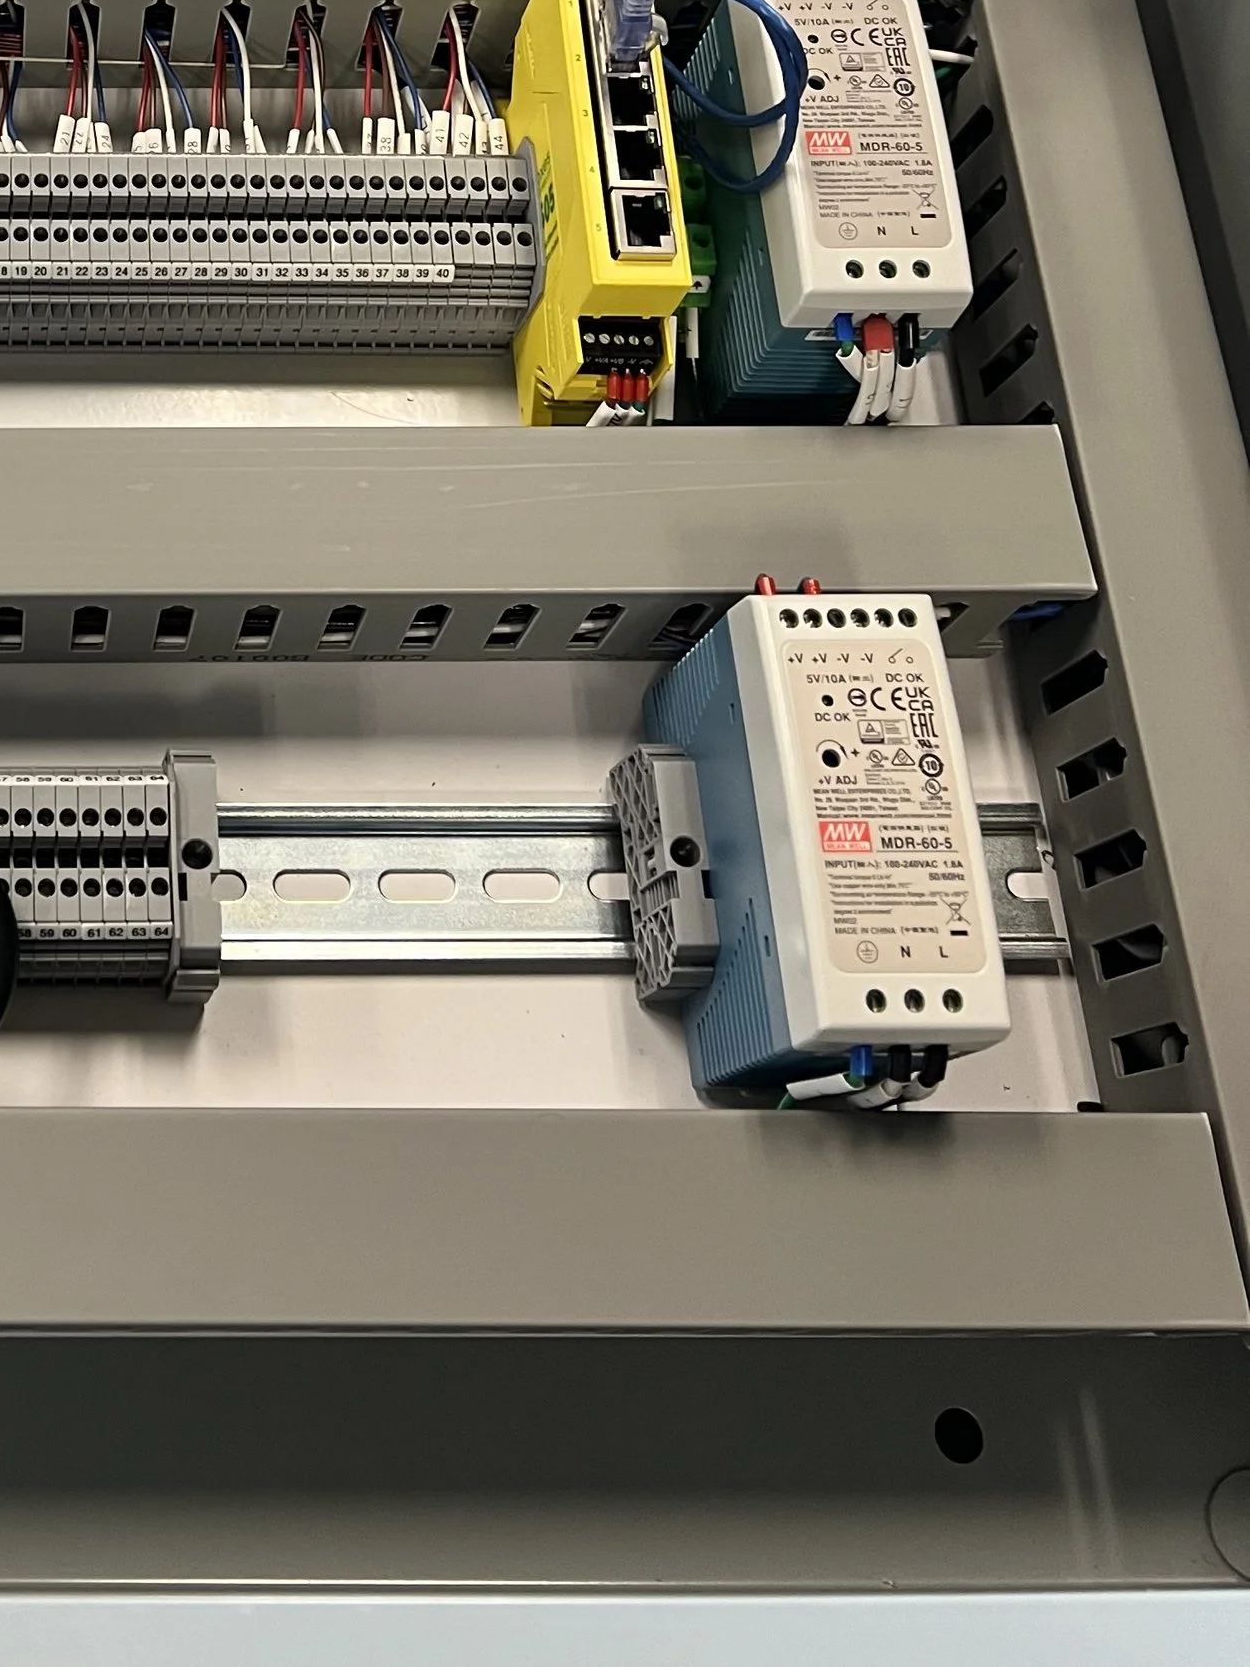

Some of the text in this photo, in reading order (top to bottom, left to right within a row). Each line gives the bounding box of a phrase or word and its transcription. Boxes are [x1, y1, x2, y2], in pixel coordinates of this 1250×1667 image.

[778, 3, 792, 11] +V
[799, 3, 813, 11] +V
[842, 3, 853, 11] -V
[794, 18, 829, 26] 5V/10A
[864, 17, 898, 25] DC OK
[881, 27, 903, 37] UK
[851, 28, 883, 47] CE
[883, 37, 907, 47] CA
[819, 47, 833, 55] OK
[575, 54, 582, 62] 2
[805, 95, 840, 103] +V ADJ
[582, 109, 589, 118] 3
[60, 131, 70, 145] 21
[436, 127, 445, 143] 41
[460, 131, 470, 149] 42
[810, 132, 847, 146] MW
[380, 137, 392, 152] 38
[494, 135, 504, 150] 44
[860, 142, 923, 152] MDR-60-5
[589, 165, 595, 174] 4
[596, 222, 602, 232] 5
[877, 226, 919, 236] N L
[16, 267, 28, 276] 19
[34, 267, 47, 276] 20
[56, 267, 68, 276] 21
[75, 267, 88, 276] 22
[95, 267, 108, 276] 23
[115, 267, 128, 276] 24
[135, 267, 148, 276] 25
[155, 267, 168, 276] 26
[175, 267, 188, 276] 27
[195, 267, 208, 276] 28
[215, 267, 228, 276] 29
[234, 267, 248, 276] 30
[256, 268, 268, 277] 31
[275, 268, 289, 277] 32
[295, 268, 308, 277] 33
[315, 268, 329, 277] 34
[336, 268, 349, 277] 35
[356, 268, 369, 277] 36
[376, 268, 389, 277] 37
[396, 268, 409, 277] 38
[416, 268, 429, 277] 39
[436, 268, 450, 277] 40
[788, 653, 873, 664] +V +V -V -V
[806, 674, 847, 684] 5V/10A
[885, 673, 903, 683] DC
[906, 673, 924, 683] OK
[905, 687, 931, 698] UK
[870, 687, 906, 711] CE
[908, 700, 934, 711] CA
[814, 713, 851, 722] DC OK
[924, 760, 938, 771] 10
[818, 775, 858, 785] +V ADJ
[823, 823, 866, 842] MW
[881, 837, 953, 849] MDR-60-5
[884, 860, 938, 869] 100-240VAC
[928, 872, 966, 881] 50/60Hz
[40, 929, 54, 938] 59
[62, 929, 77, 938] 60
[87, 929, 100, 938] 61
[109, 928, 123, 937] 62
[132, 928, 146, 937] 63
[154, 927, 168, 936] 64
[900, 946, 949, 958] N L
